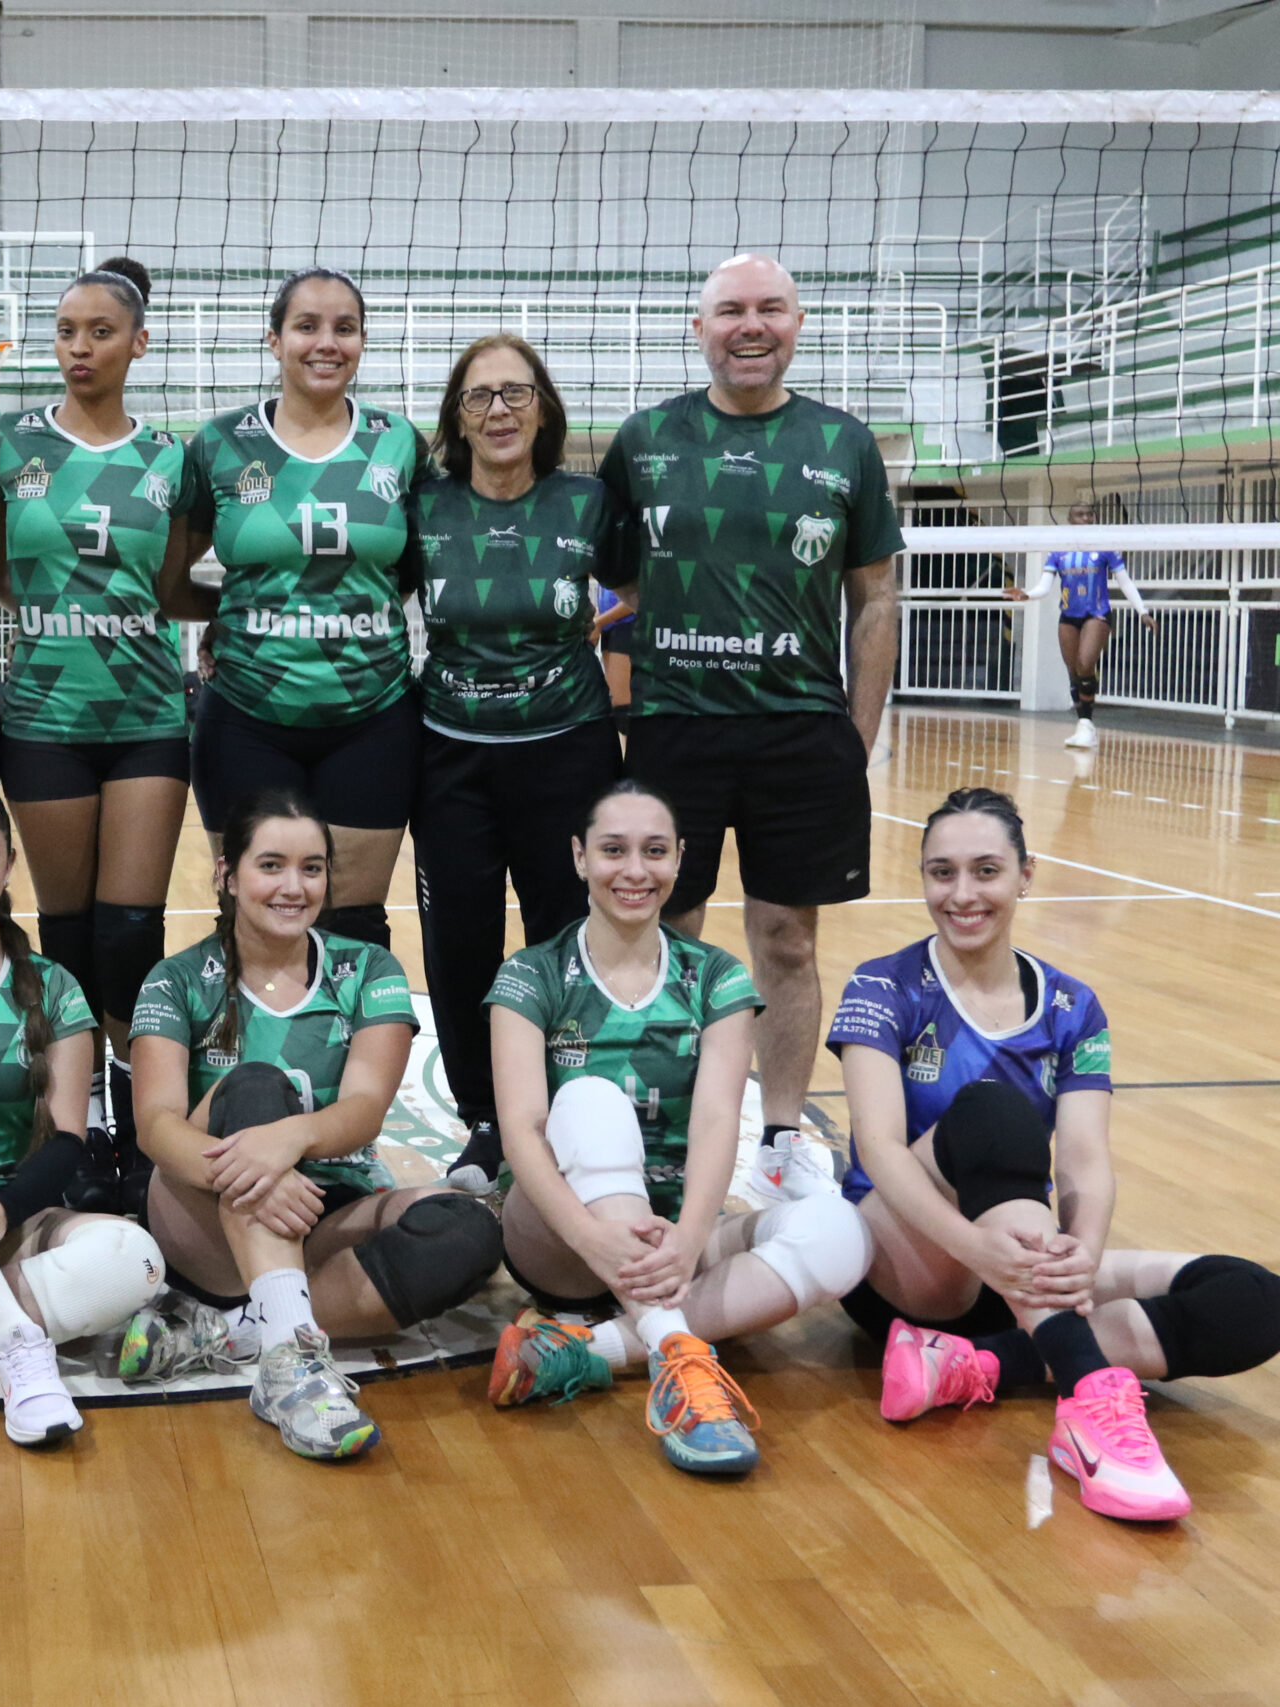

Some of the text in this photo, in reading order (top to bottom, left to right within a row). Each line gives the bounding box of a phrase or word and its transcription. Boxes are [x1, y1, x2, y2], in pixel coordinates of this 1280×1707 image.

[78, 504, 111, 557] 3
[297, 502, 347, 555] 13
[20, 603, 159, 638] Unimed
[246, 602, 391, 639] Unimed
[655, 627, 764, 655] Unimed
[669, 656, 761, 671] Poços de Caldas
[371, 985, 410, 999] Unime
